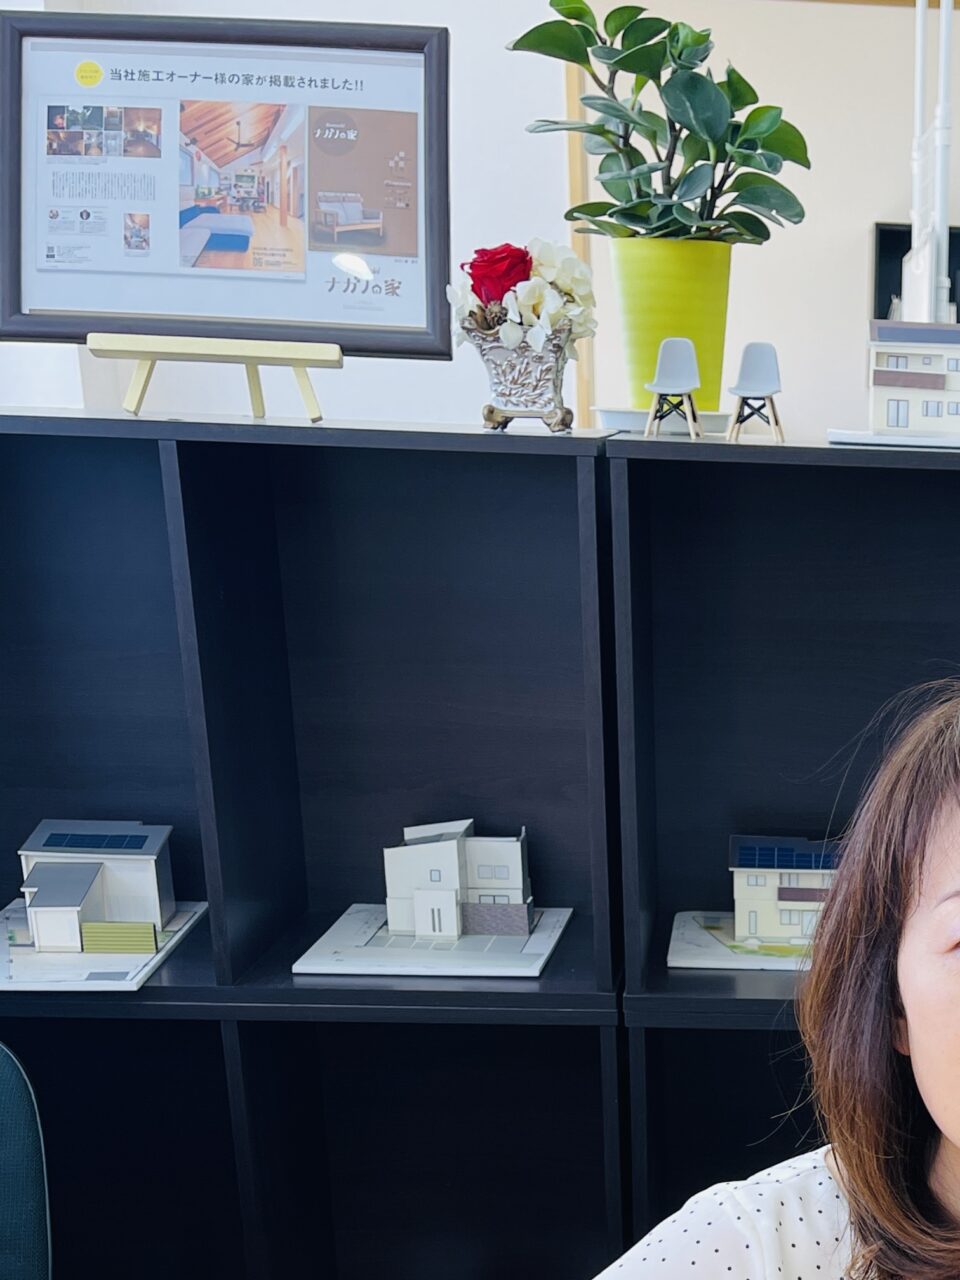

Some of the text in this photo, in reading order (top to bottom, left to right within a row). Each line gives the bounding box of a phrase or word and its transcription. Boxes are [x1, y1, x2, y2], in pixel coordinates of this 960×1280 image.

[109, 67, 365, 92] 当社施工オーナー様の家が掲載されました!!
